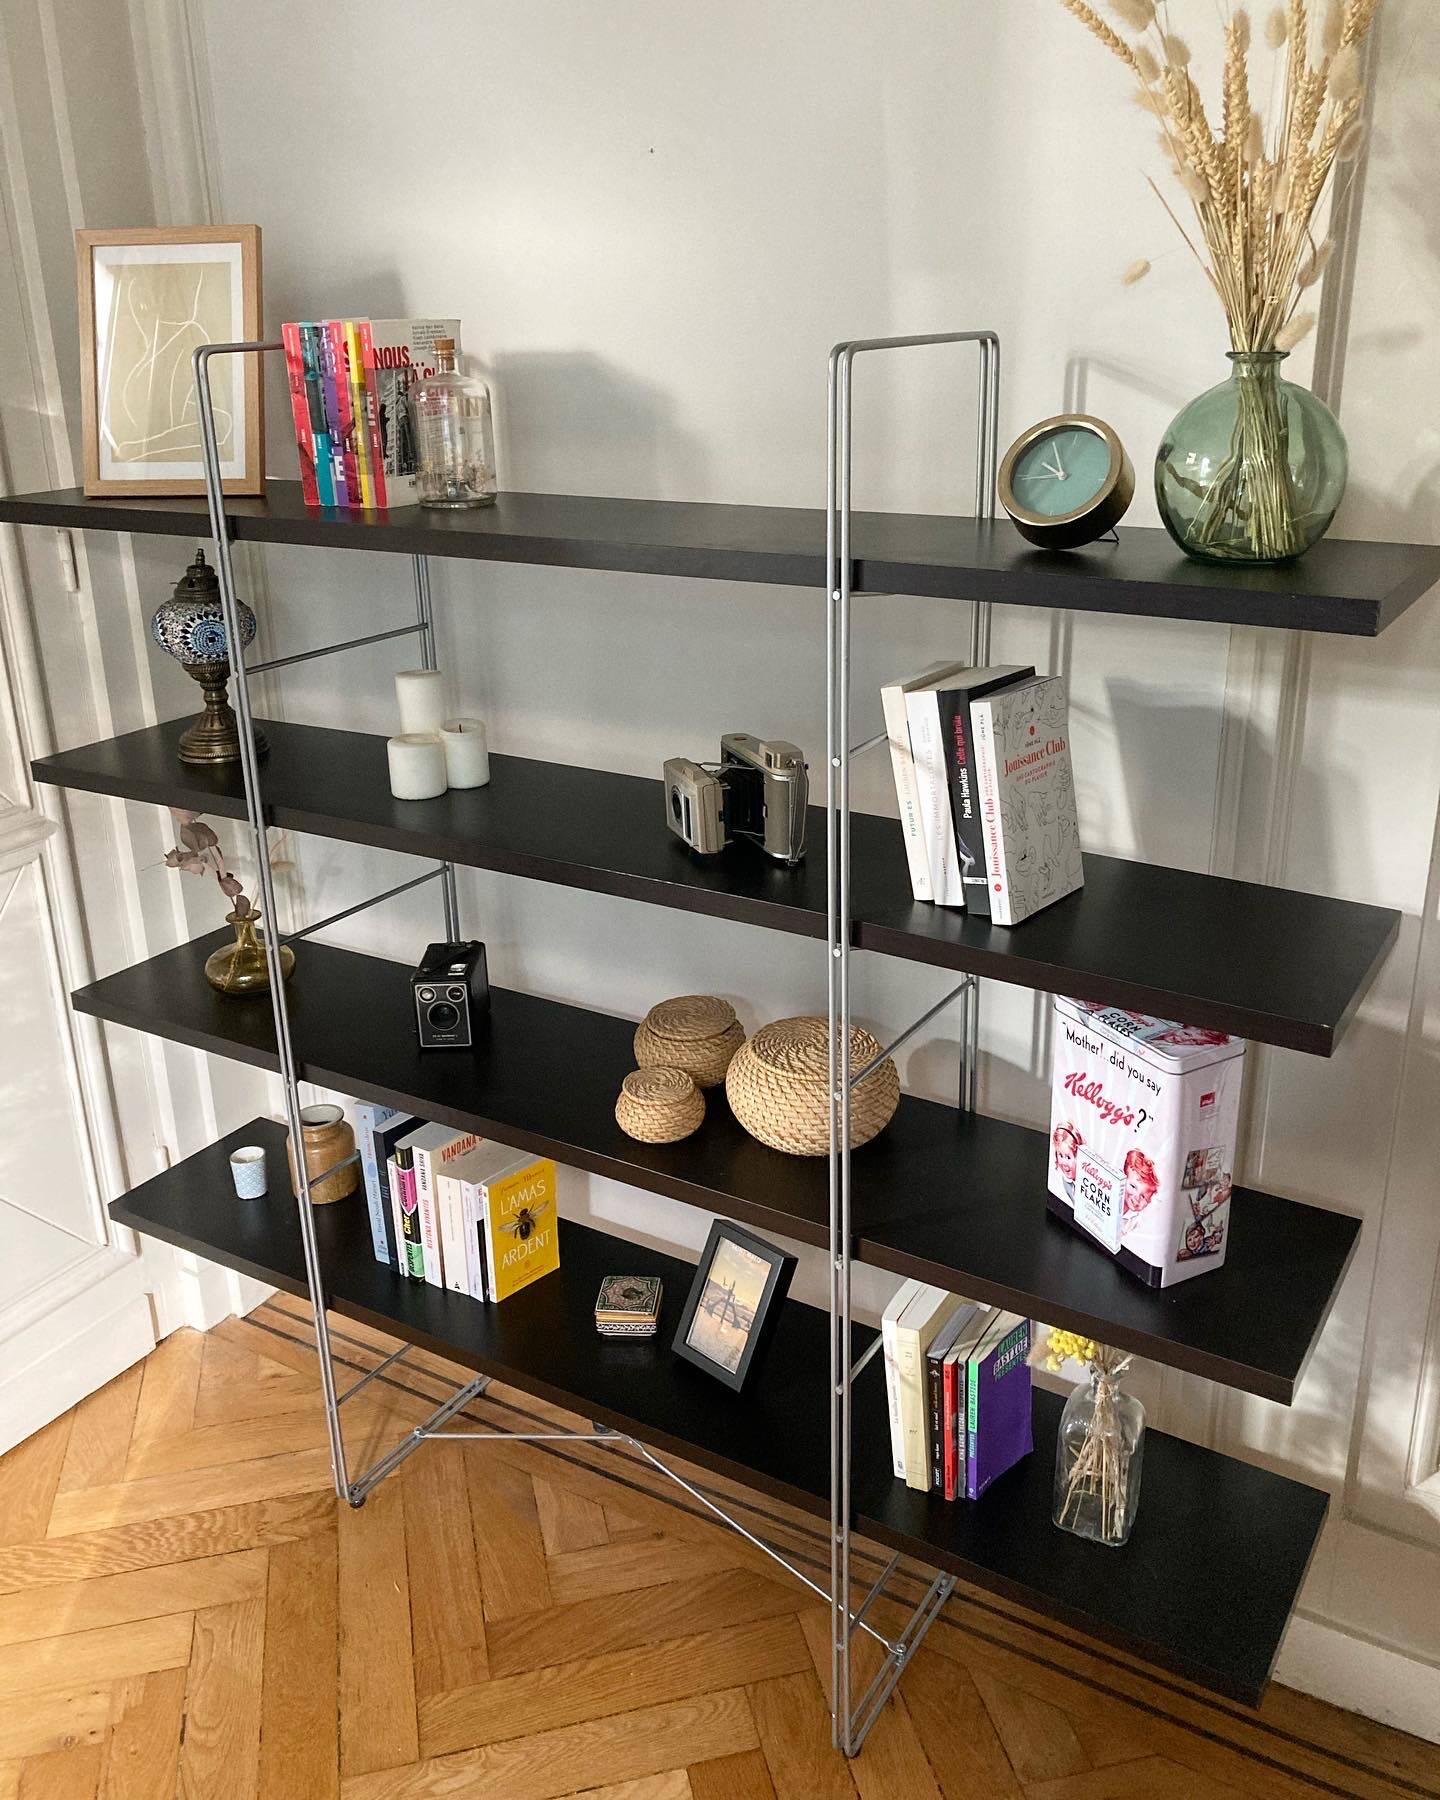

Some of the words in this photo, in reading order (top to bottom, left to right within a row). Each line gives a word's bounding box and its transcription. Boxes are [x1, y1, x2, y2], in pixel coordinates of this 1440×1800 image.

[1004, 748, 1045, 778] Jouissance
[1046, 737, 1066, 756] Club
[960, 768, 971, 798] Hawkins
[963, 798, 973, 819] Paula
[984, 798, 997, 823] Club
[989, 824, 1002, 879] Jouissance
[1098, 1014, 1134, 1037] FLAKES
[1110, 1012, 1142, 1031] CORN
[1128, 1065, 1145, 1083] you
[1146, 1078, 1162, 1096] say
[441, 1136, 477, 1163] VANDANA
[1080, 1185, 1112, 1217] FLAKES
[1083, 1177, 1111, 1205] CORN
[403, 1214, 412, 1235] Cher
[501, 1230, 551, 1270] ARDENT
[998, 1324, 1028, 1357] LAUREN
[993, 1337, 1028, 1375] BASTIDE
